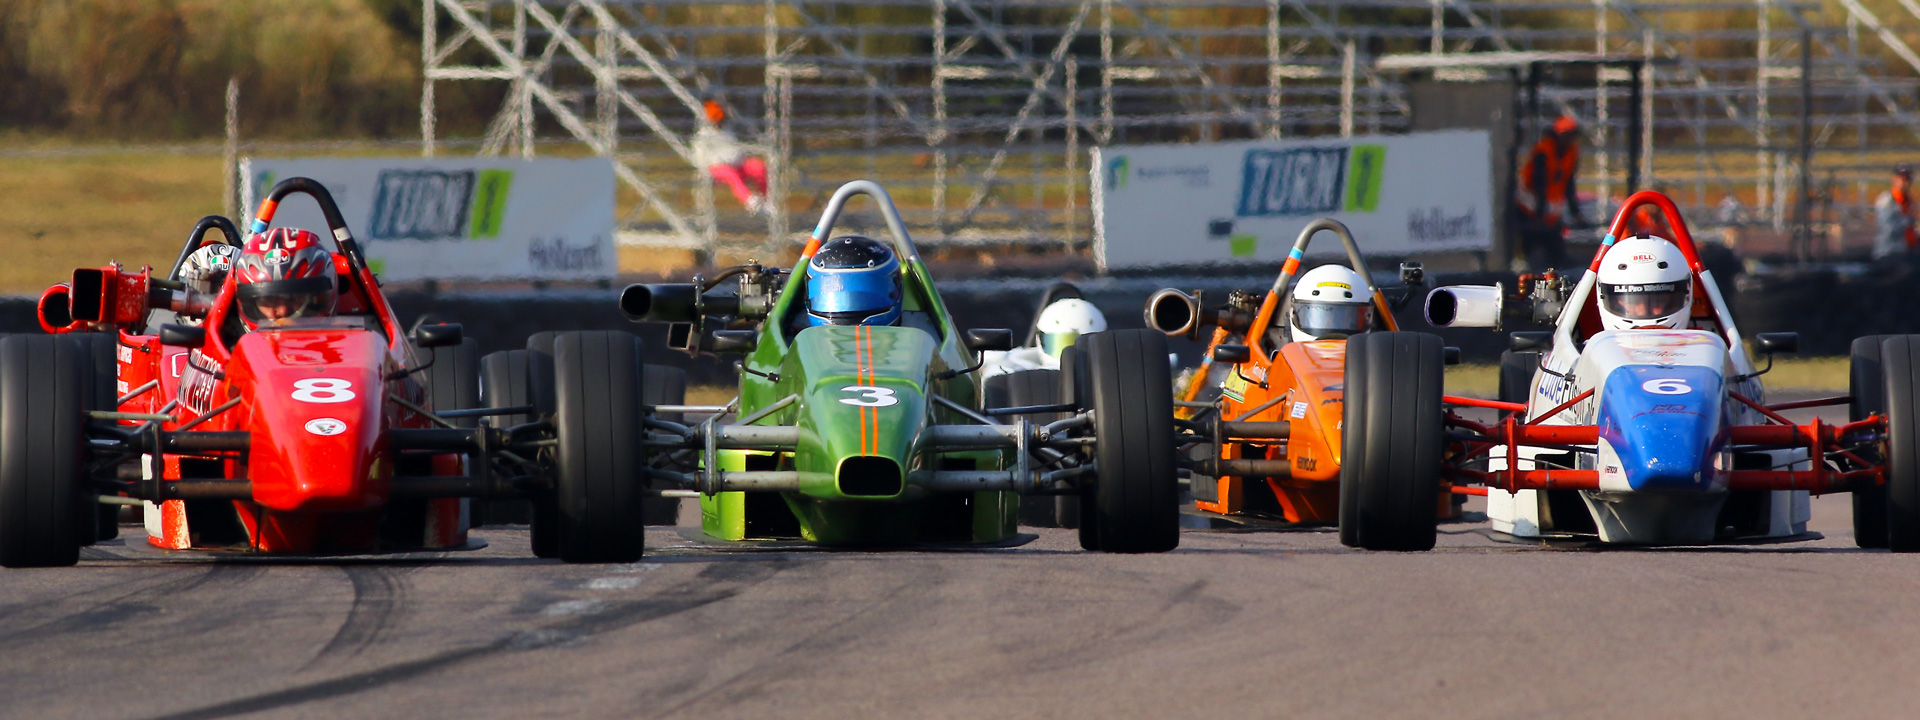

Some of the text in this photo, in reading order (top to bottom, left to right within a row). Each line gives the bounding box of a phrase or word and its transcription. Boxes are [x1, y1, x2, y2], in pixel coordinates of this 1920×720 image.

[1243, 150, 1341, 214] TURN
[376, 171, 467, 237] TURN
[1628, 285, 1643, 293] Pro
[291, 378, 356, 403] 8
[839, 385, 900, 407] 3
[1642, 378, 1692, 395] 6
